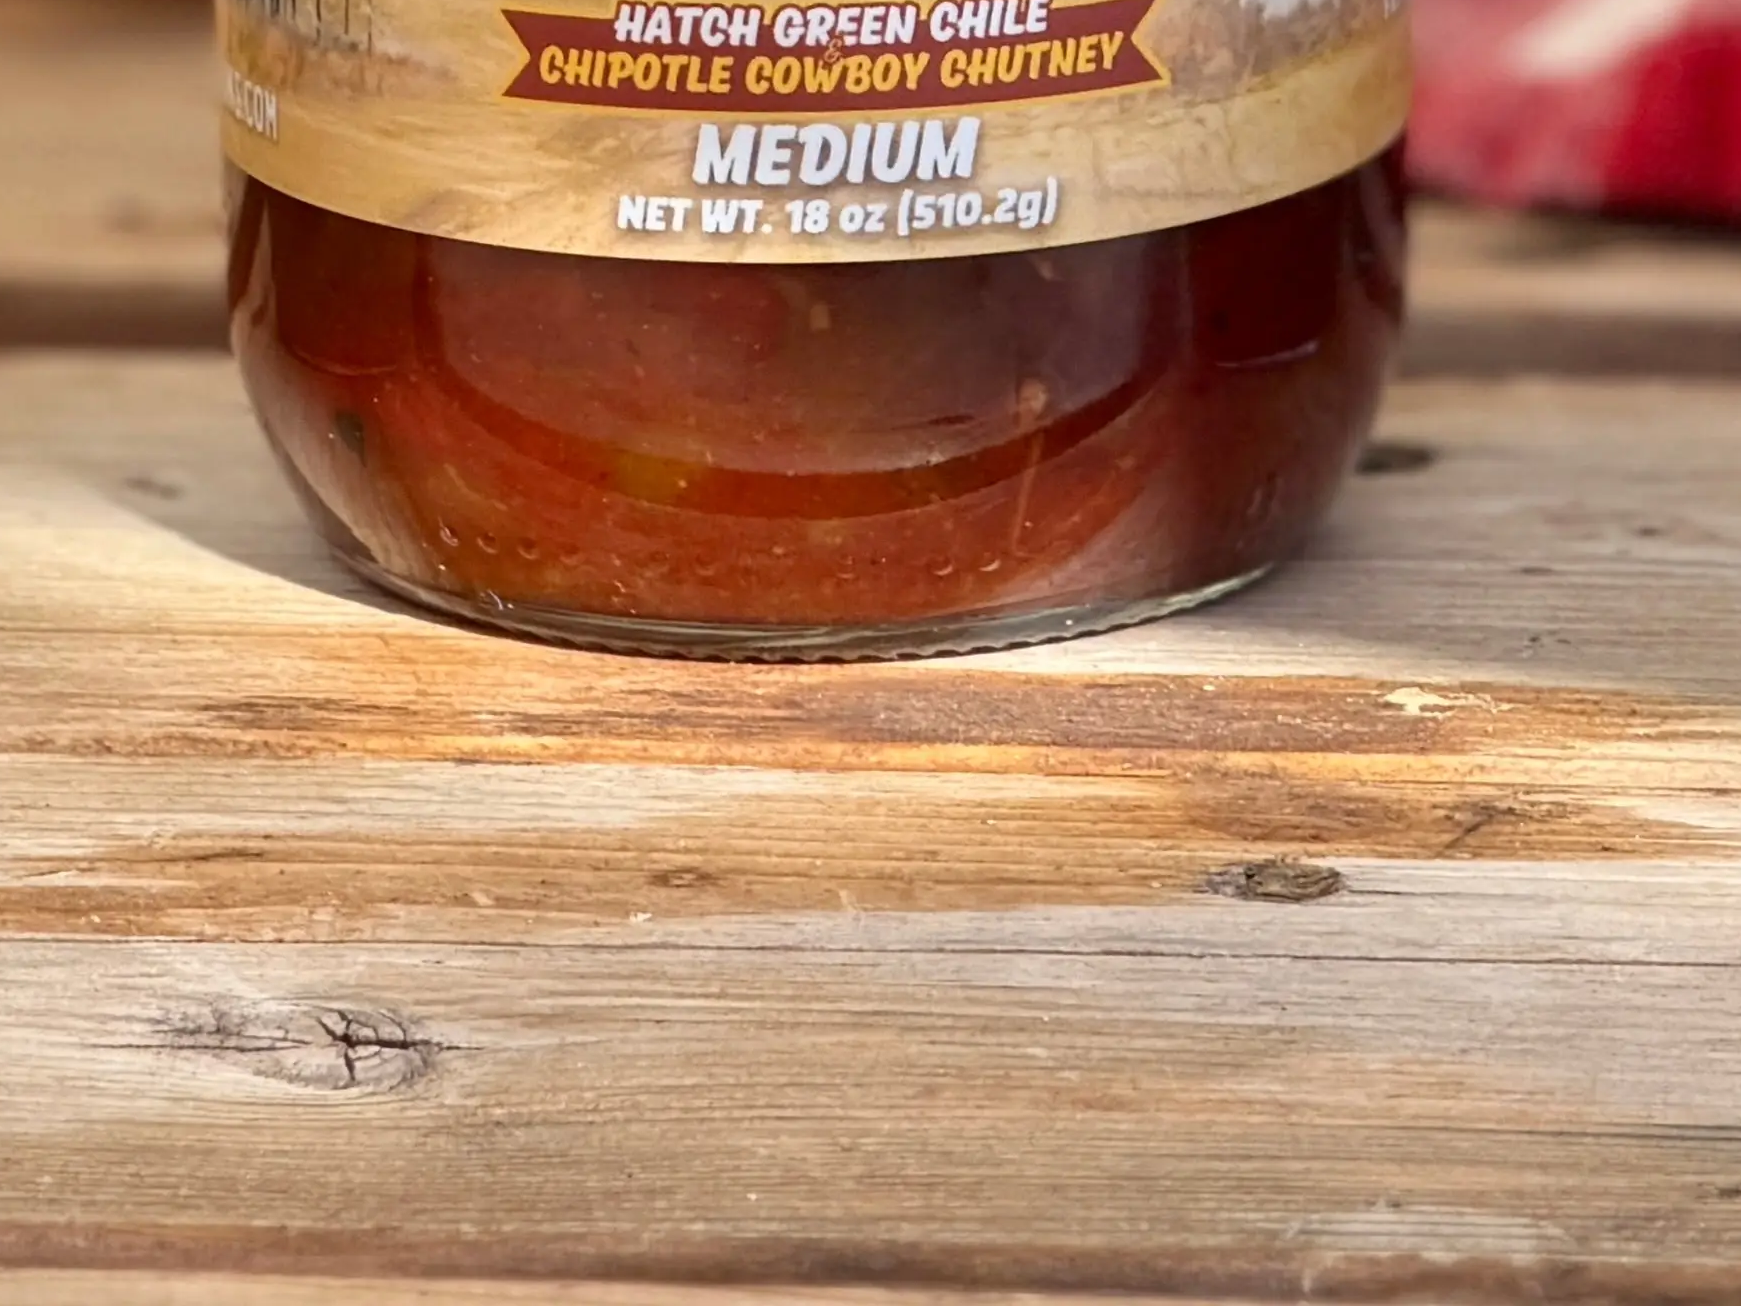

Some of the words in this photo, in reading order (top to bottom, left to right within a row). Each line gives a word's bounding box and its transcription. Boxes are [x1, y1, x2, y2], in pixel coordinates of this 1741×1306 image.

[612, 1, 761, 48] HATCH
[772, 2, 918, 49] GREEN
[538, 44, 732, 95] CHIPOTLE
[744, 51, 931, 95] COWBOY
[939, 30, 1125, 89] CHUTNEY
[691, 116, 982, 186] MEDIUM
[616, 194, 693, 233] NET
[700, 198, 774, 235] WT.
[785, 198, 830, 234] 18
[838, 203, 886, 232] oz
[896, 176, 1059, 237] (510.2g)
